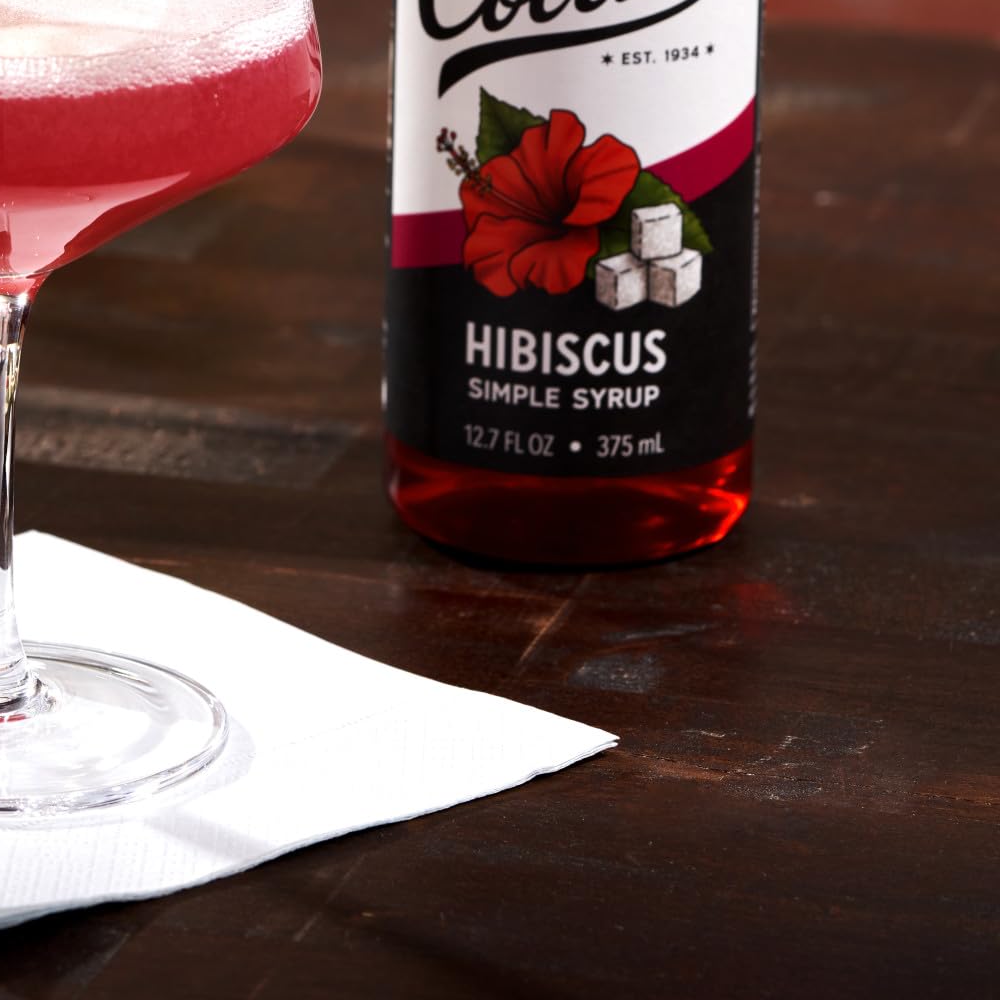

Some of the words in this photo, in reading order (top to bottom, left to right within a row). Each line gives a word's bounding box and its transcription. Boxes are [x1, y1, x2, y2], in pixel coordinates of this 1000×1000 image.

[621, 52, 656, 66] EST.
[664, 46, 700, 63] 1934
[465, 321, 668, 377] HIBISCUS
[468, 377, 561, 409] SIMPLE
[572, 385, 661, 410] SYRUP
[464, 424, 499, 450] 12.7
[504, 430, 524, 455] FL
[529, 434, 555, 457] OZ
[597, 434, 633, 458] 375
[638, 431, 665, 454] mL
